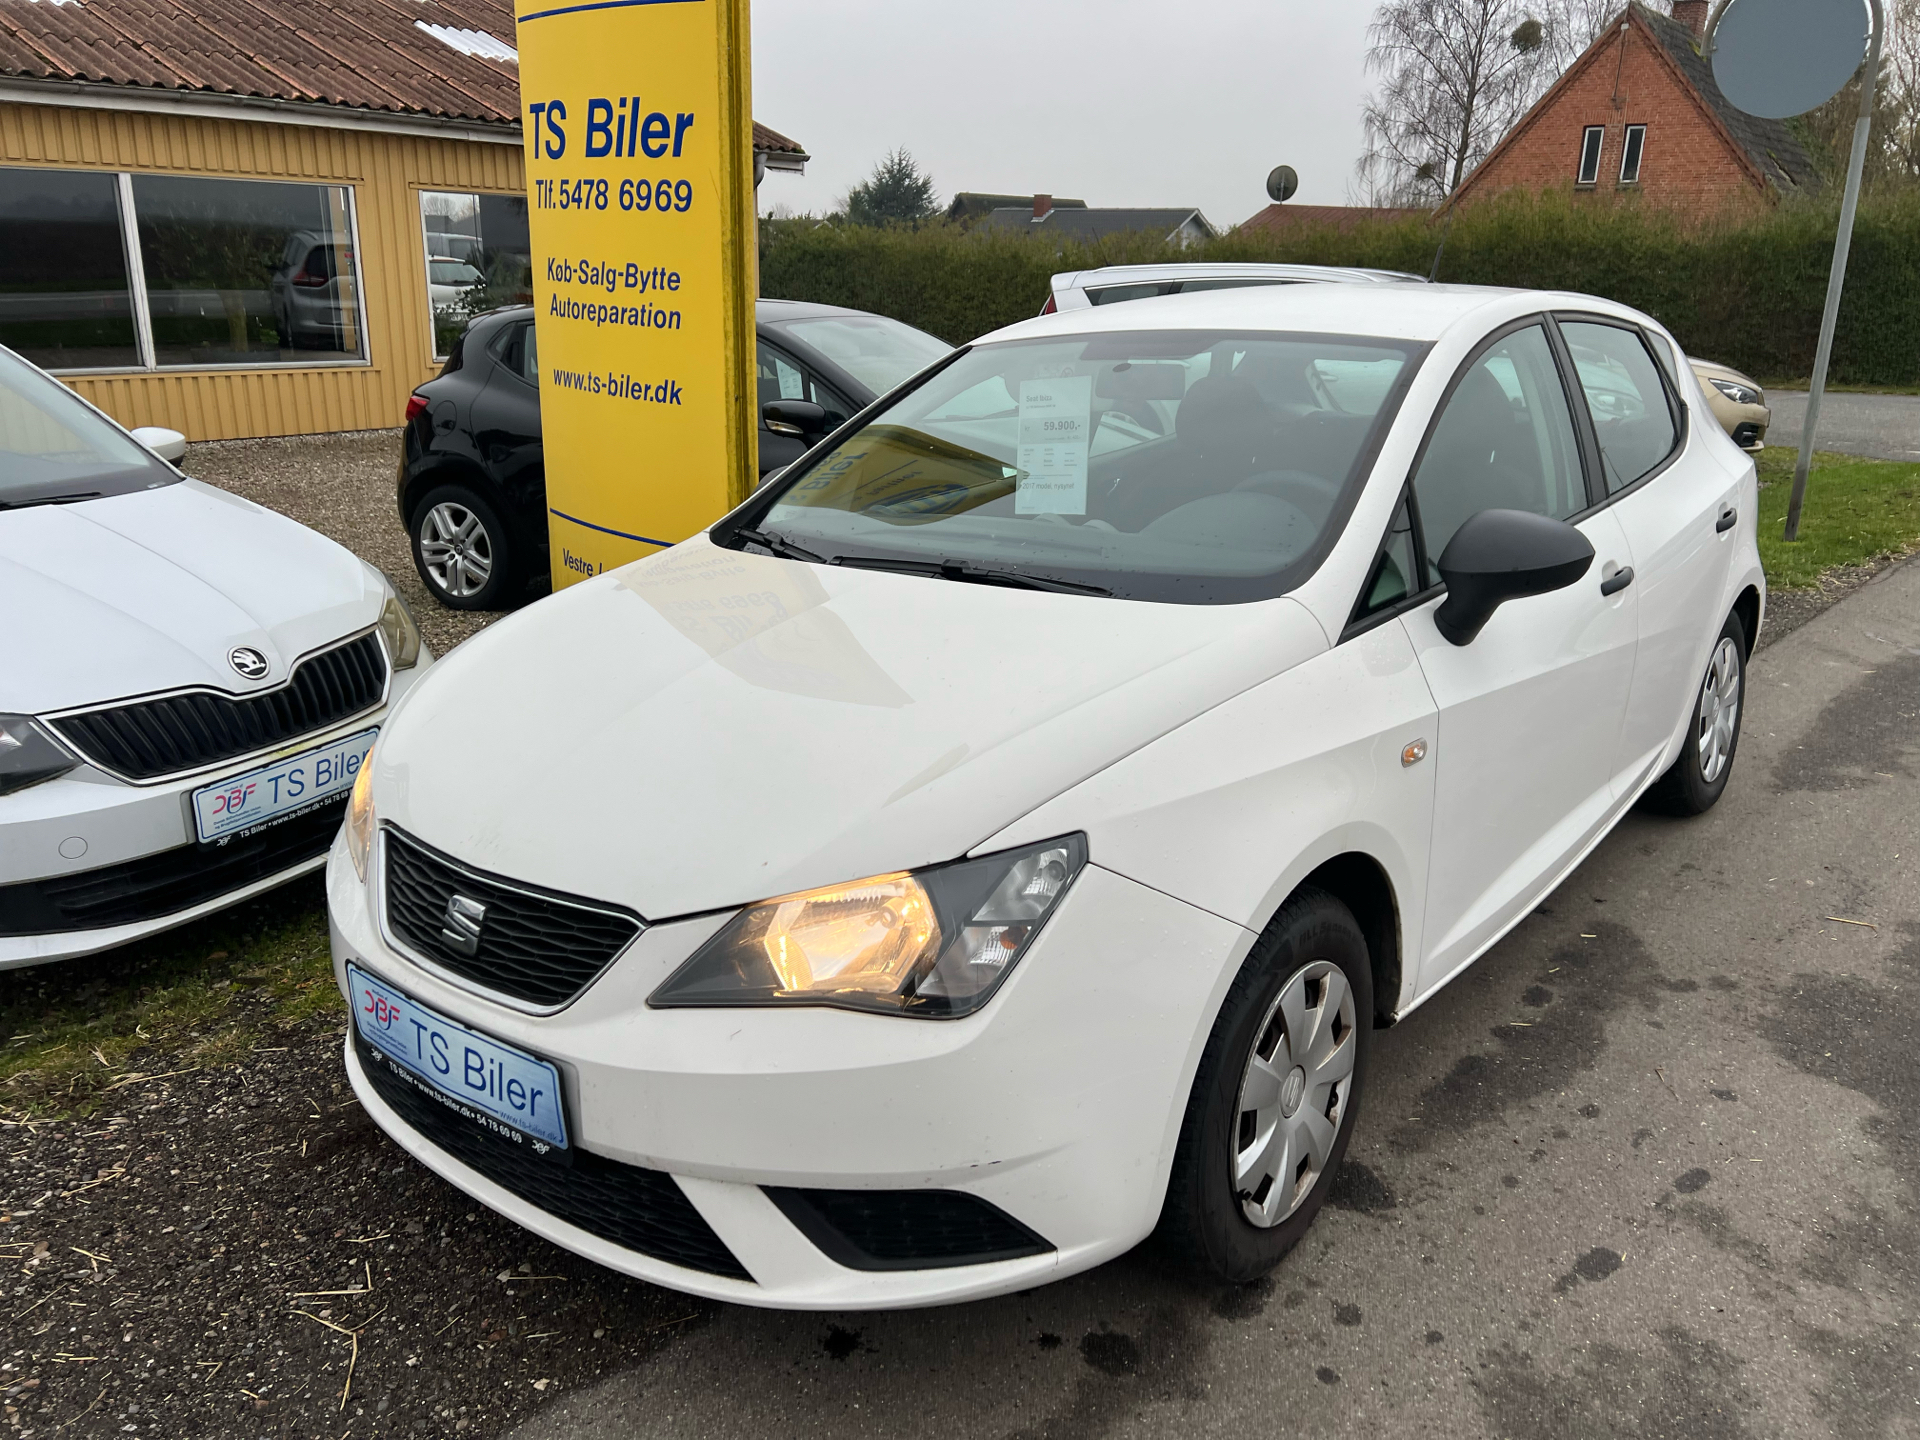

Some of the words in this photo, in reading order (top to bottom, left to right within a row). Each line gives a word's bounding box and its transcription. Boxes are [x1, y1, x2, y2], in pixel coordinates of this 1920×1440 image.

[529, 100, 567, 160] TS
[585, 96, 694, 158] Biler
[619, 179, 693, 212] 6969
[547, 257, 681, 294] Køb-Salg-Bytte
[550, 293, 681, 329] Autoreparation
[553, 368, 683, 405] www.ts-biler.dk
[1026, 395, 1039, 403] Seat
[1043, 420, 1081, 431] 59.900,-
[562, 547, 593, 577] Vestre
[267, 769, 305, 804] TS
[239, 829, 251, 839] TS
[251, 823, 267, 835] Biler
[410, 1018, 450, 1075] TS
[464, 1046, 543, 1117] Biler
[388, 1061, 399, 1073] TS
[398, 1068, 414, 1084] Biler
[476, 1114, 487, 1127] 54
[487, 1119, 499, 1132] 78
[499, 1124, 511, 1138] 69
[511, 1130, 523, 1144] 69
[500, 1110, 558, 1143] www.ts-biler.dk
